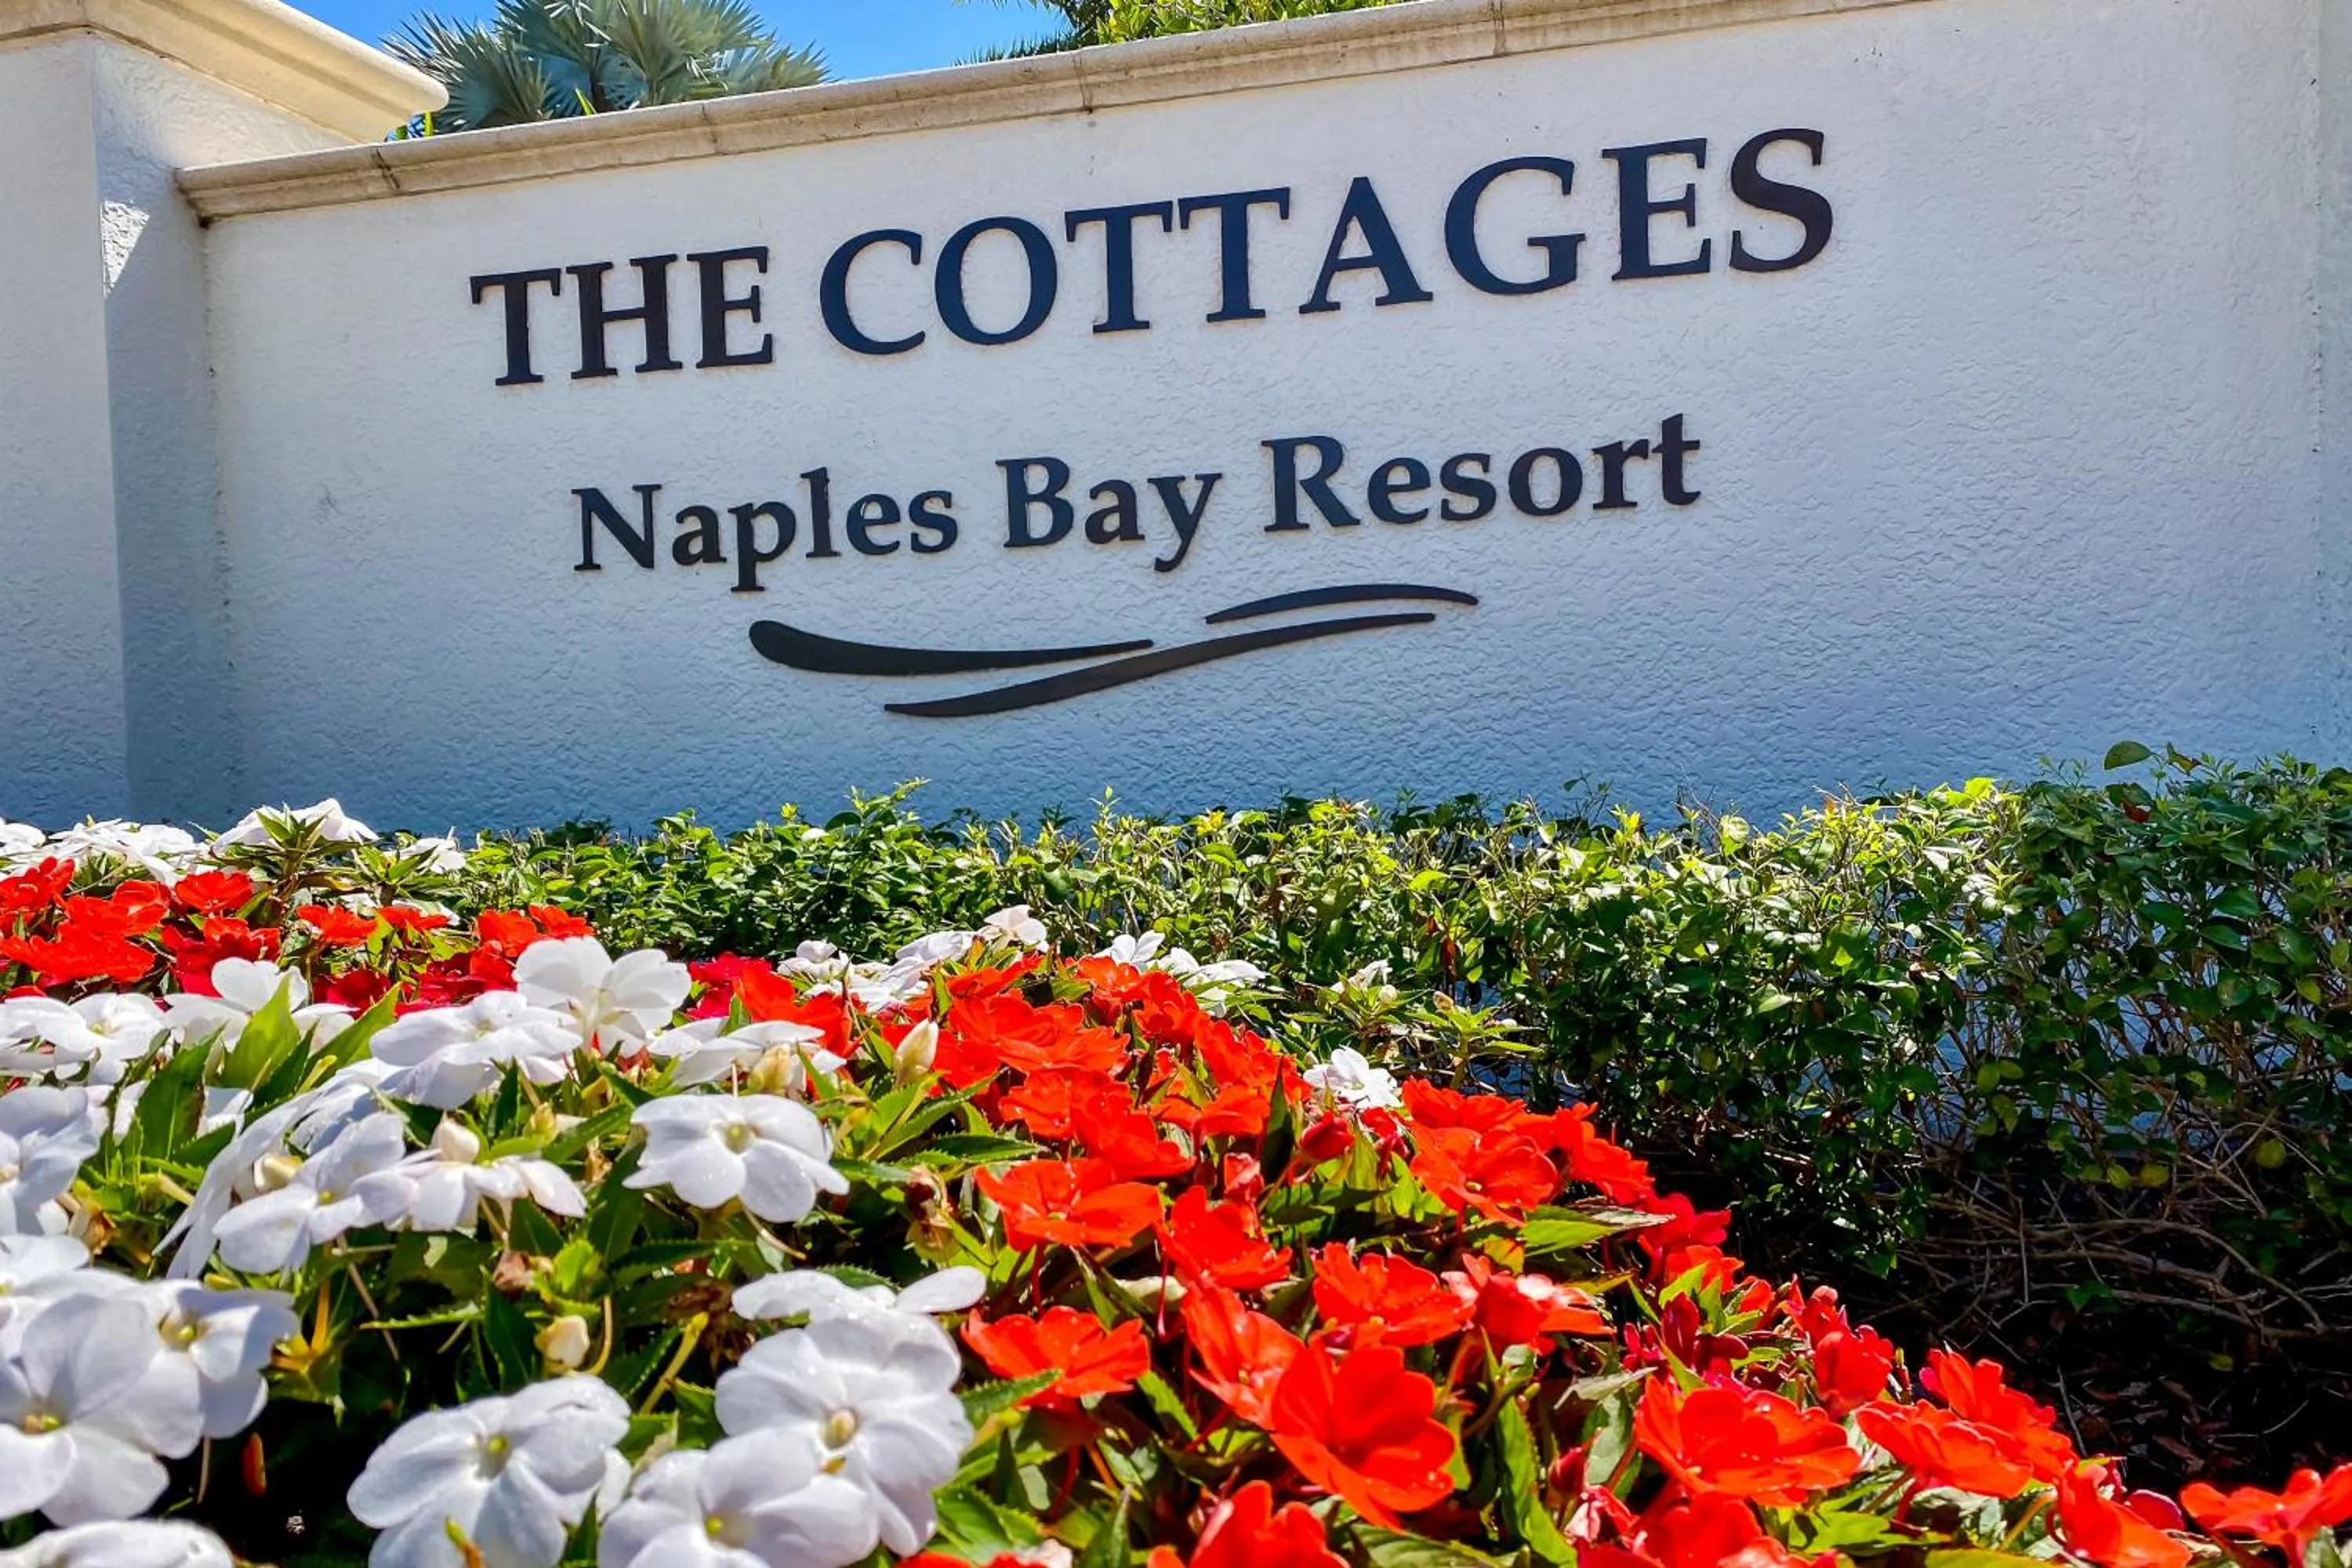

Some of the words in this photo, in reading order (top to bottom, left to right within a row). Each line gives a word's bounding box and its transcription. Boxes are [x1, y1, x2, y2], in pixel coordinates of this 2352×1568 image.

[470, 245, 775, 387] THE
[819, 128, 1834, 357] COTTAGES
[571, 466, 959, 594] Naples
[995, 456, 1224, 575] Bay
[1261, 413, 1702, 534] Resort
